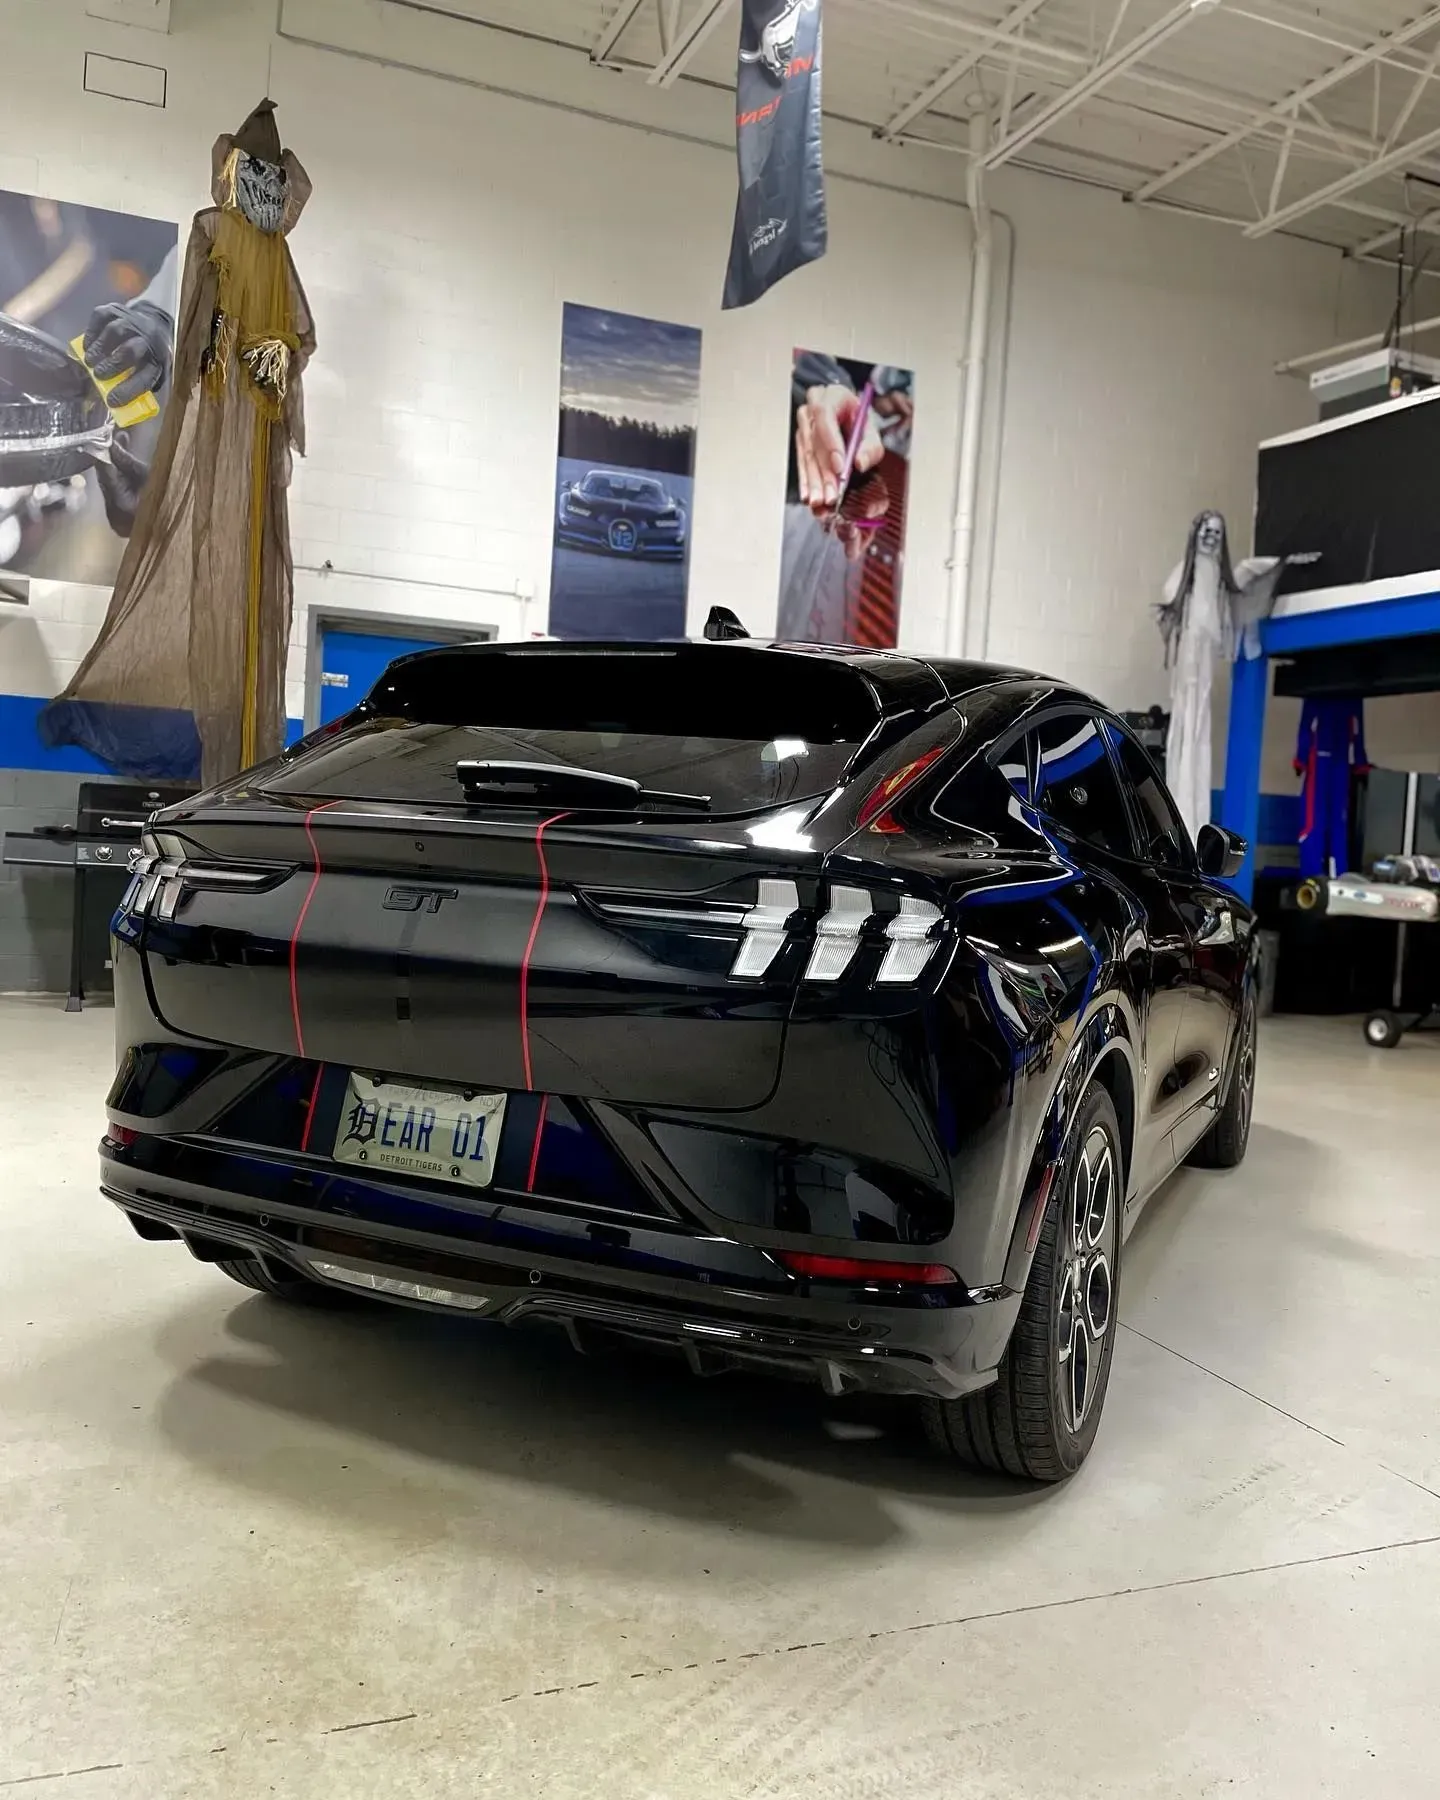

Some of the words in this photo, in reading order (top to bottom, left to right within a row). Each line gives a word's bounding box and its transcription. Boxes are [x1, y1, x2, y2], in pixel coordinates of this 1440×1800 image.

[382, 886, 459, 913] GT
[380, 1153, 412, 1167] DETROIT
[415, 1159, 443, 1172] TIGERS
